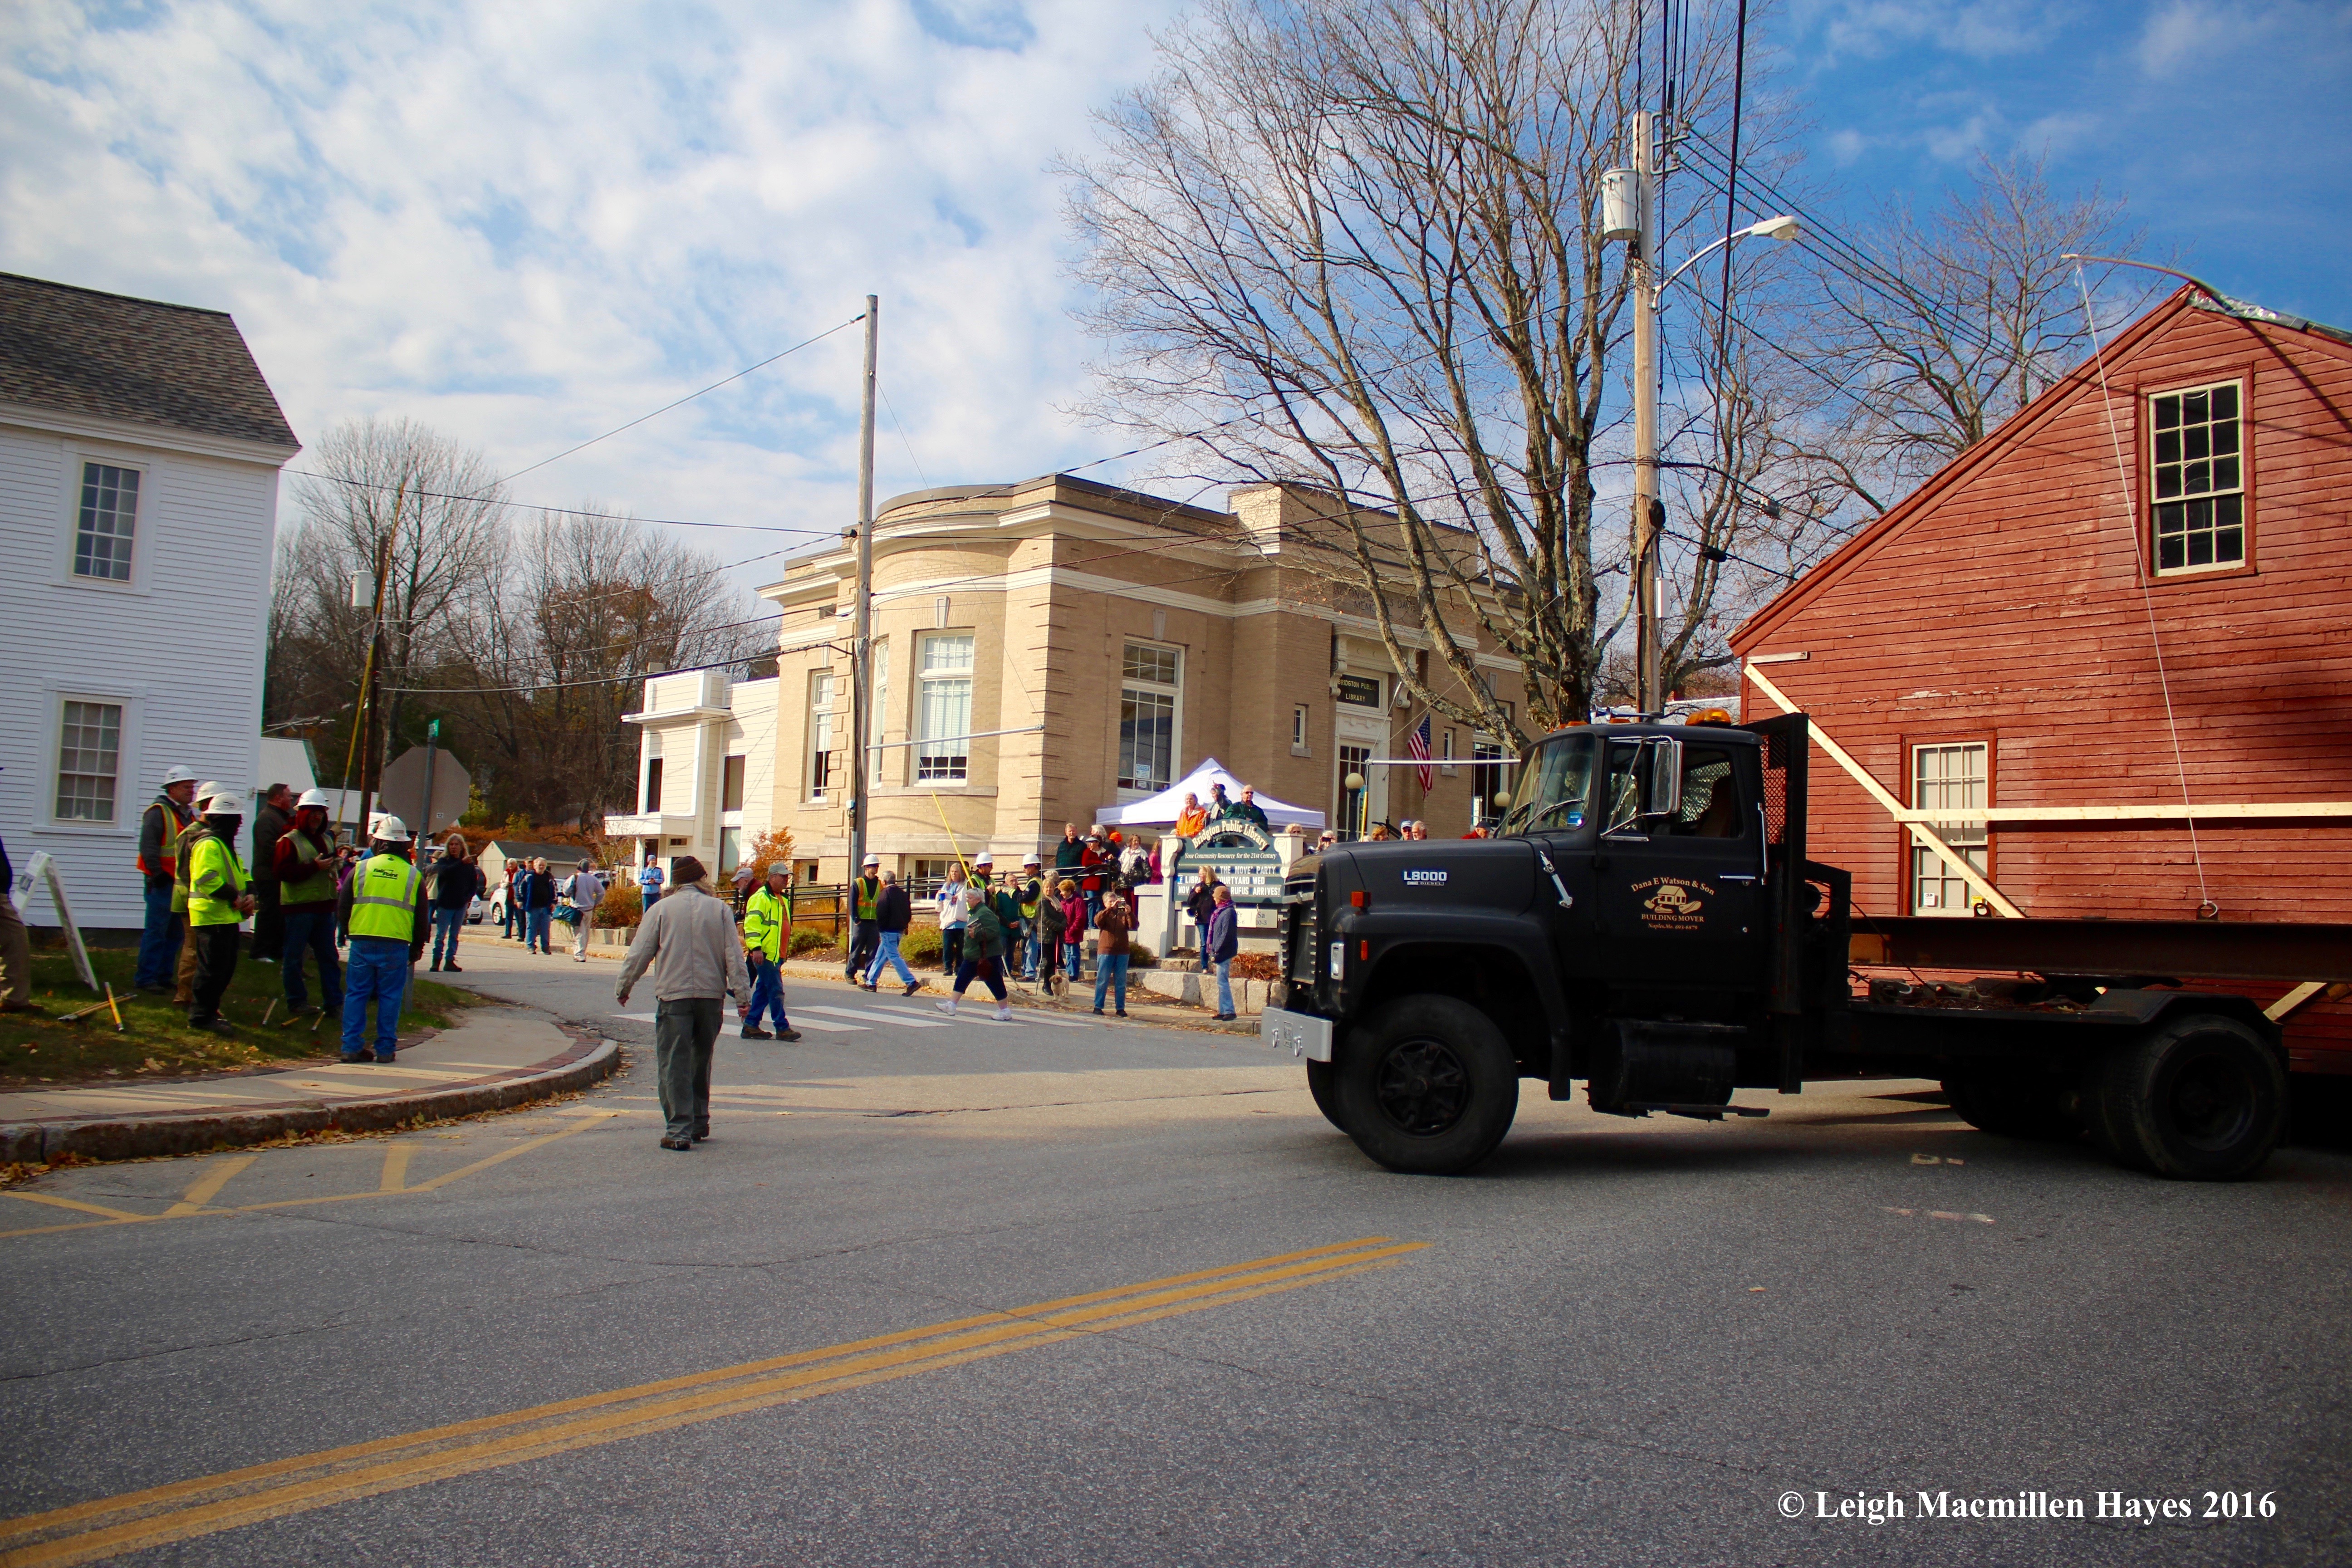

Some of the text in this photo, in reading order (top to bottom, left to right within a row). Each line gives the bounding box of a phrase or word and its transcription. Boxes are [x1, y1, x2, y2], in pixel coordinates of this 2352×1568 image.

[1338, 679, 1376, 691] BRIDGTON PUBLIC
[1346, 693, 1366, 702] LIBRARY
[1192, 819, 1269, 851] Bridgton Public Library
[1220, 866, 1231, 874] THE
[1256, 866, 1276, 874] PARTY
[1252, 877, 1265, 885] WED
[1404, 871, 1447, 881] L8000
[1178, 886, 1280, 896] NOV RUFUS ARRIVES!
[1631, 880, 1652, 892] Dana
[1660, 877, 1690, 886] Watson
[1700, 883, 1715, 896] Son
